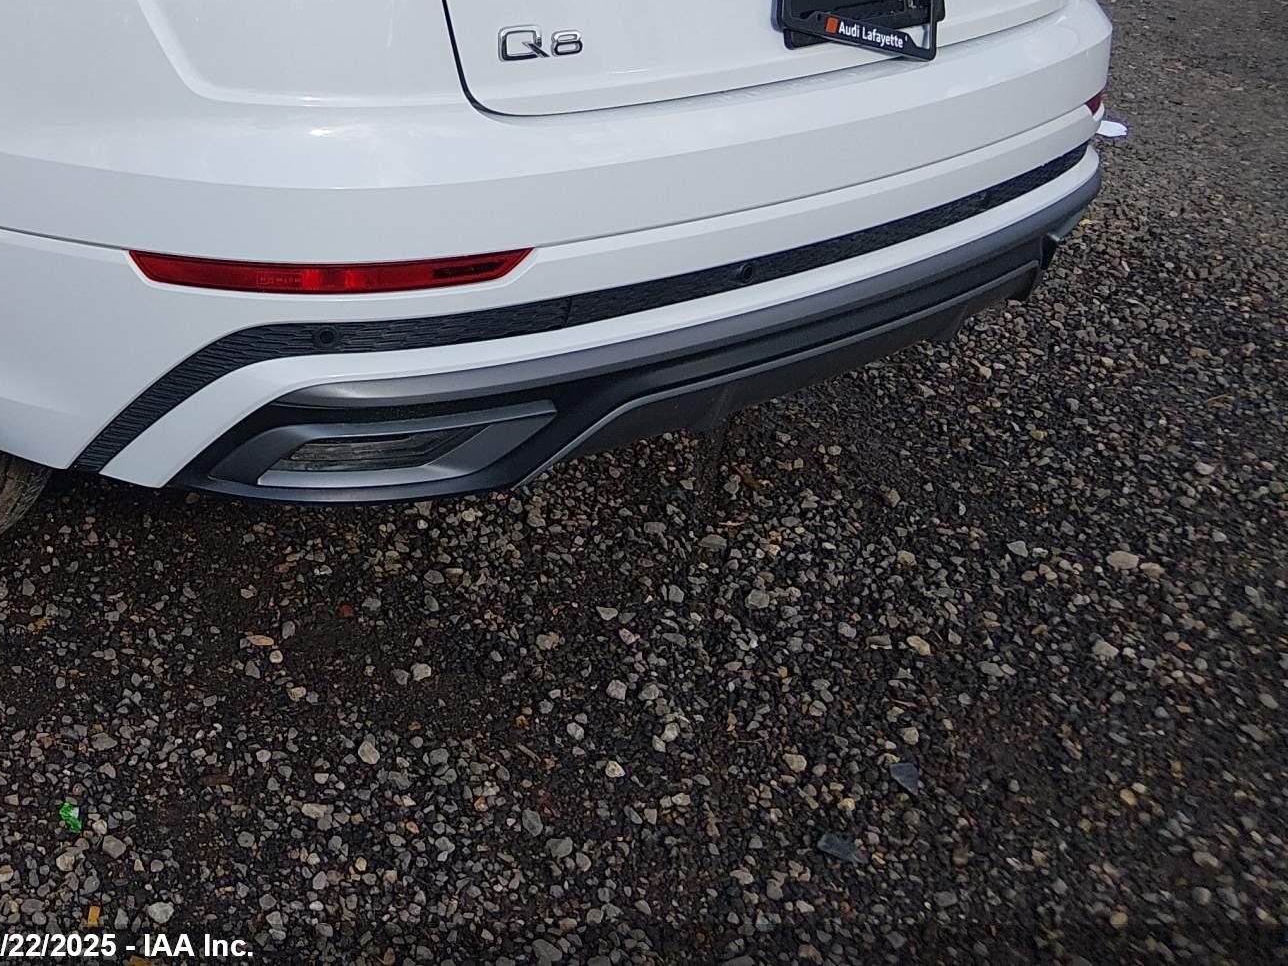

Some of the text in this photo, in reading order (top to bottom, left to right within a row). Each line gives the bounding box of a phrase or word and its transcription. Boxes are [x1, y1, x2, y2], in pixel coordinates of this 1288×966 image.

[498, 24, 583, 62] Q8
[839, 22, 904, 48] Audi Lafayette
